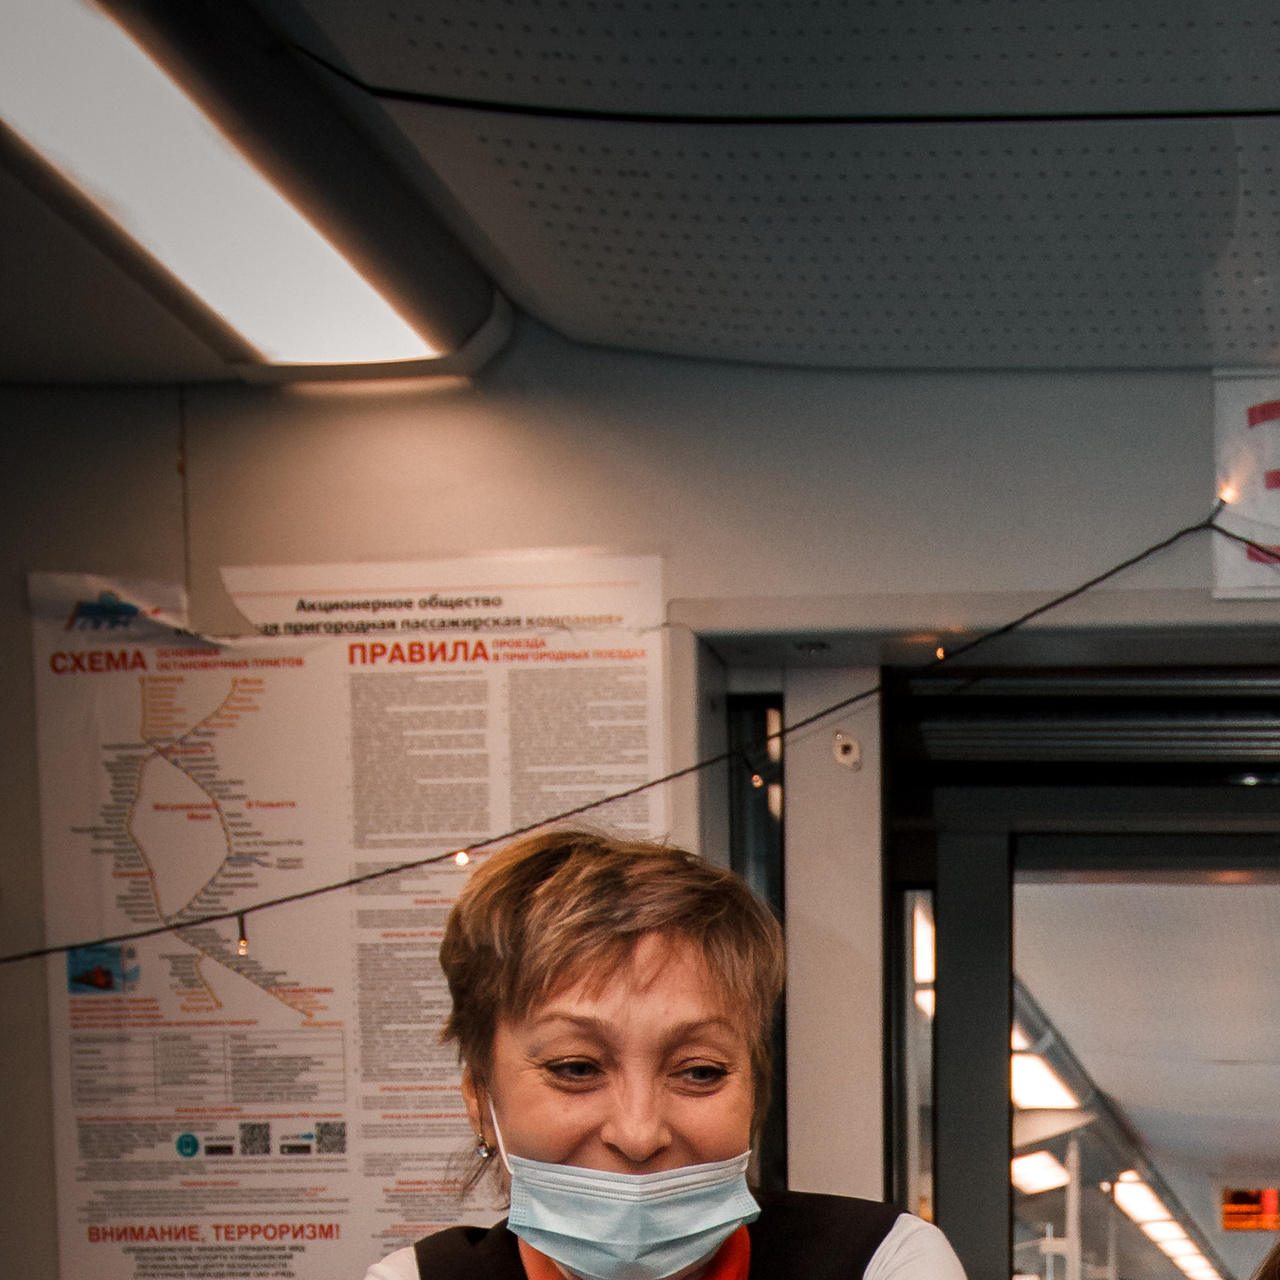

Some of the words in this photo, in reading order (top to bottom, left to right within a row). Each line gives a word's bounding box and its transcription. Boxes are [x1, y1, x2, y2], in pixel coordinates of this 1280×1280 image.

[296, 599, 413, 614] Акционерное
[418, 593, 503, 609] общество
[283, 618, 396, 636] пригородная
[401, 616, 521, 632] пассажирская
[348, 640, 489, 665] ПРАВИЛА
[492, 638, 546, 649] ПРОЕЗДА
[50, 650, 148, 674] СХЕМА
[502, 650, 589, 662] ПРИГОРОДНЫХ
[591, 648, 646, 660] ПОЕЗДАХ
[88, 1224, 207, 1243] ВНИМАНИЕ,
[212, 1223, 340, 1242] ТЕРРОРИЗМ!
